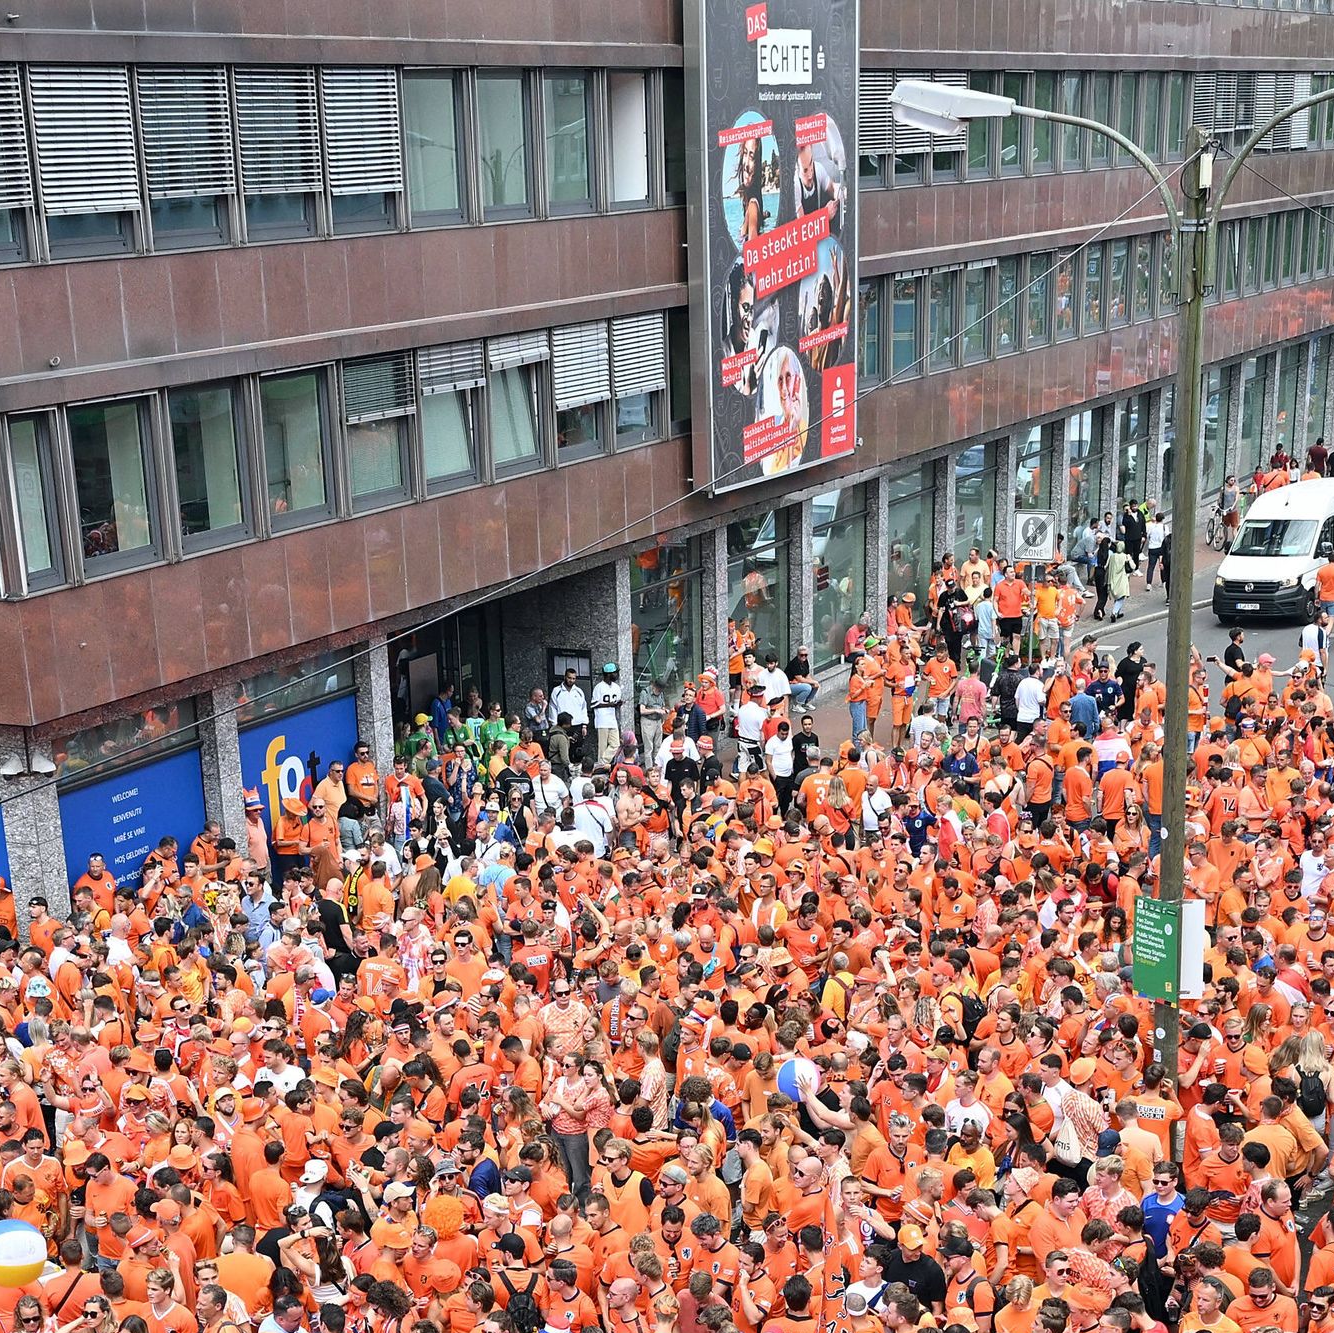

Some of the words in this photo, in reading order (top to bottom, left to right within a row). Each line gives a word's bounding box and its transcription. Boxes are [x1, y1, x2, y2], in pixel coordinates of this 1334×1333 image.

[747, 12, 767, 35] DAS
[760, 44, 809, 72] ECHTE
[805, 91, 822, 100] Dortmund
[719, 125, 772, 143] Reiserückvergütung
[746, 249, 759, 267] Da
[762, 227, 798, 260] steckt
[801, 216, 826, 241] ECHT
[758, 265, 783, 292] mehr
[787, 251, 815, 279] drin!
[722, 371, 741, 384] Schutz
[1022, 548, 1044, 557] ZONE
[112, 788, 139, 803] WELCOME!
[1223, 799, 1236, 812] 14
[113, 807, 143, 824] BENVENUTI!
[587, 879, 602, 895] 36
[1145, 910, 1161, 920] Stadion
[1147, 933, 1165, 944] Viewing
[1136, 944, 1150, 954] Subway
[1151, 947, 1167, 959] Station
